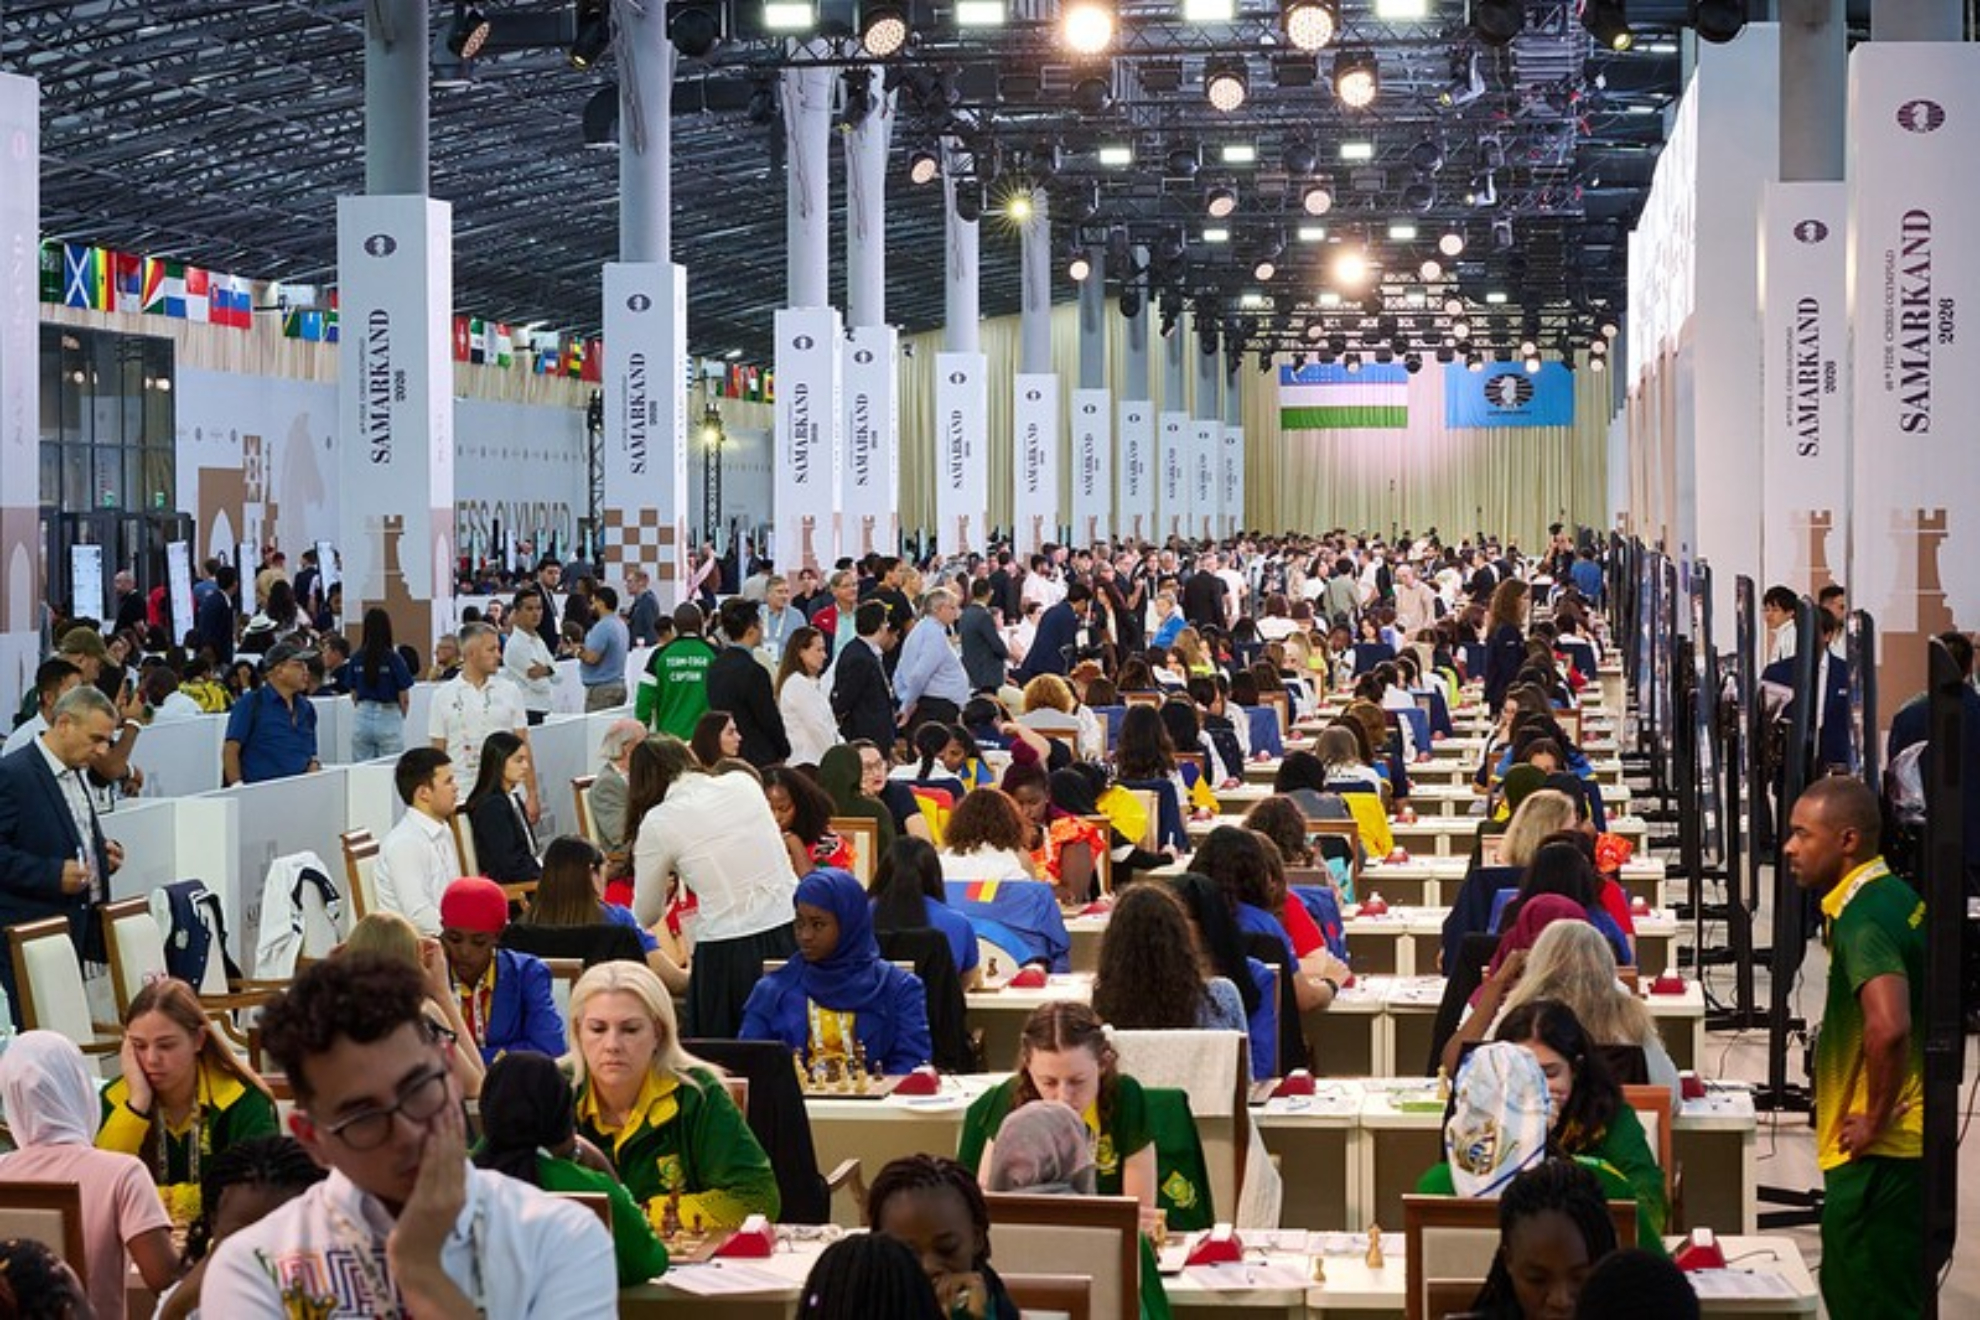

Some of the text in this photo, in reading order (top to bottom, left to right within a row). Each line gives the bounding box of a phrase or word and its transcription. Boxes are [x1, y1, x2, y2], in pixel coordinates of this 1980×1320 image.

[1902, 210, 1931, 434] SAMARKAND
[1938, 298, 1954, 345] 2026
[368, 308, 391, 464] SAMARKAND
[629, 352, 646, 475] SAMARKAND
[1797, 297, 1819, 457] SAMARKAND
[1824, 360, 1836, 394] 2026
[794, 383, 808, 484] SAMARKAND
[855, 393, 869, 486] SAMARKAND
[951, 410, 962, 489] SAMARKAND
[454, 501, 489, 555] ESS
